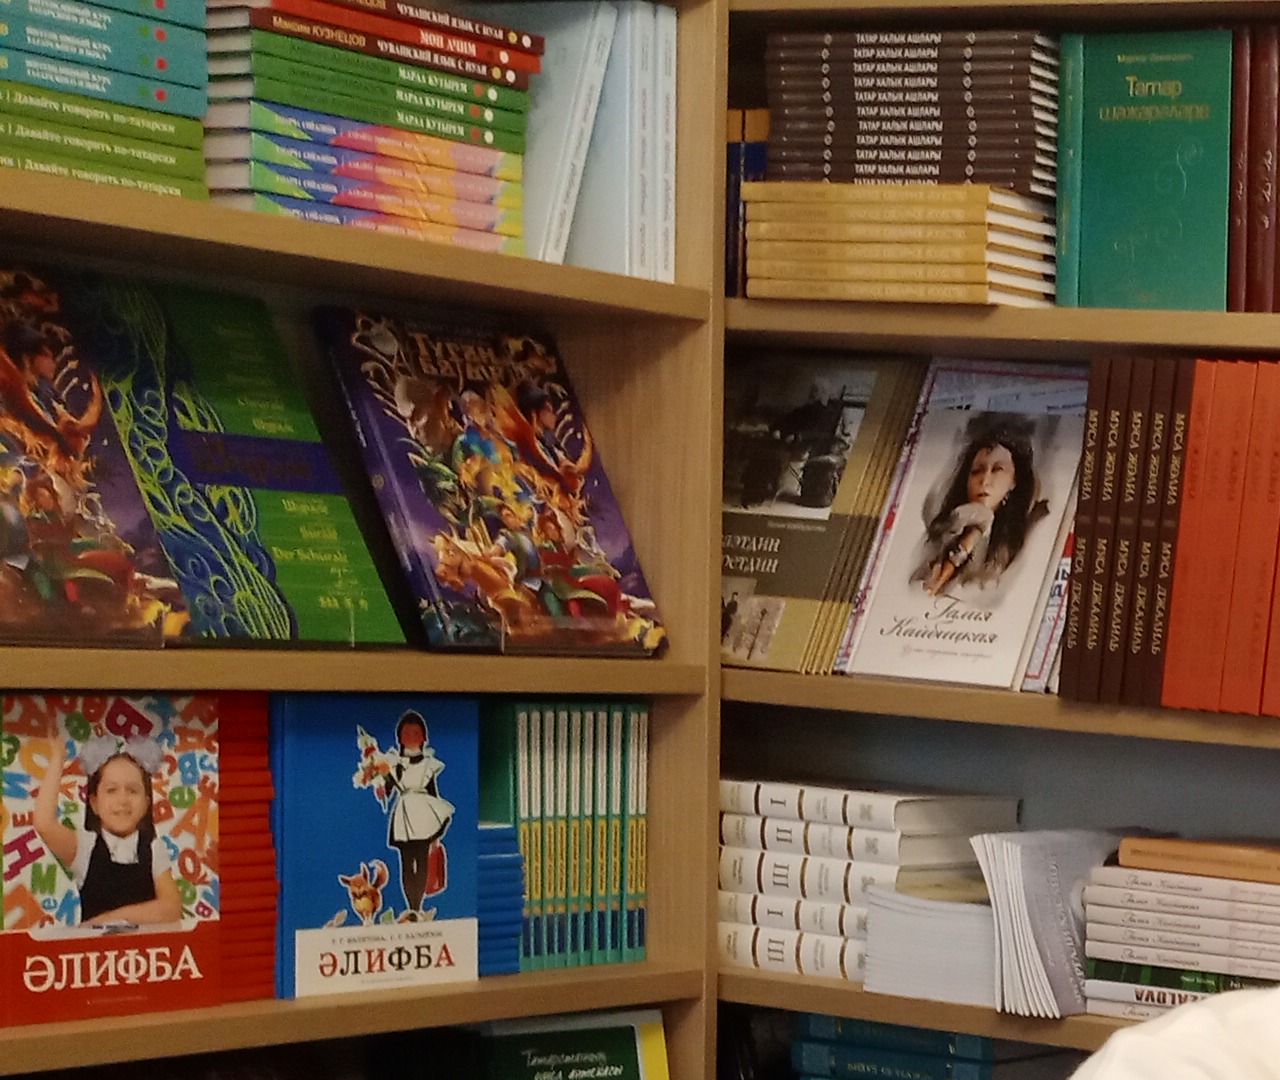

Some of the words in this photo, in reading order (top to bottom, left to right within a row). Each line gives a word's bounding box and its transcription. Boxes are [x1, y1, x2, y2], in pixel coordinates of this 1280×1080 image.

[312, 25, 365, 48] КУЗНЕЦОВ
[853, 49, 875, 58] ТАТАР
[1126, 75, 1182, 98] Татар
[857, 107, 878, 117] ТАТАР
[856, 135, 878, 146] ТАТАР
[855, 164, 876, 174] ТАТАР
[1108, 410, 1119, 448] МУСА
[1173, 413, 1185, 451] МУСА
[1095, 538, 1107, 574] МУСА
[1159, 542, 1171, 578] МУСА
[1087, 580, 1102, 649] ДЖАЛИЛЬ
[1151, 584, 1166, 655] ДЖАЛИЛЬ
[23, 946, 203, 992] ӘЛИФБА
[318, 944, 455, 977] ӘЛИФБА
